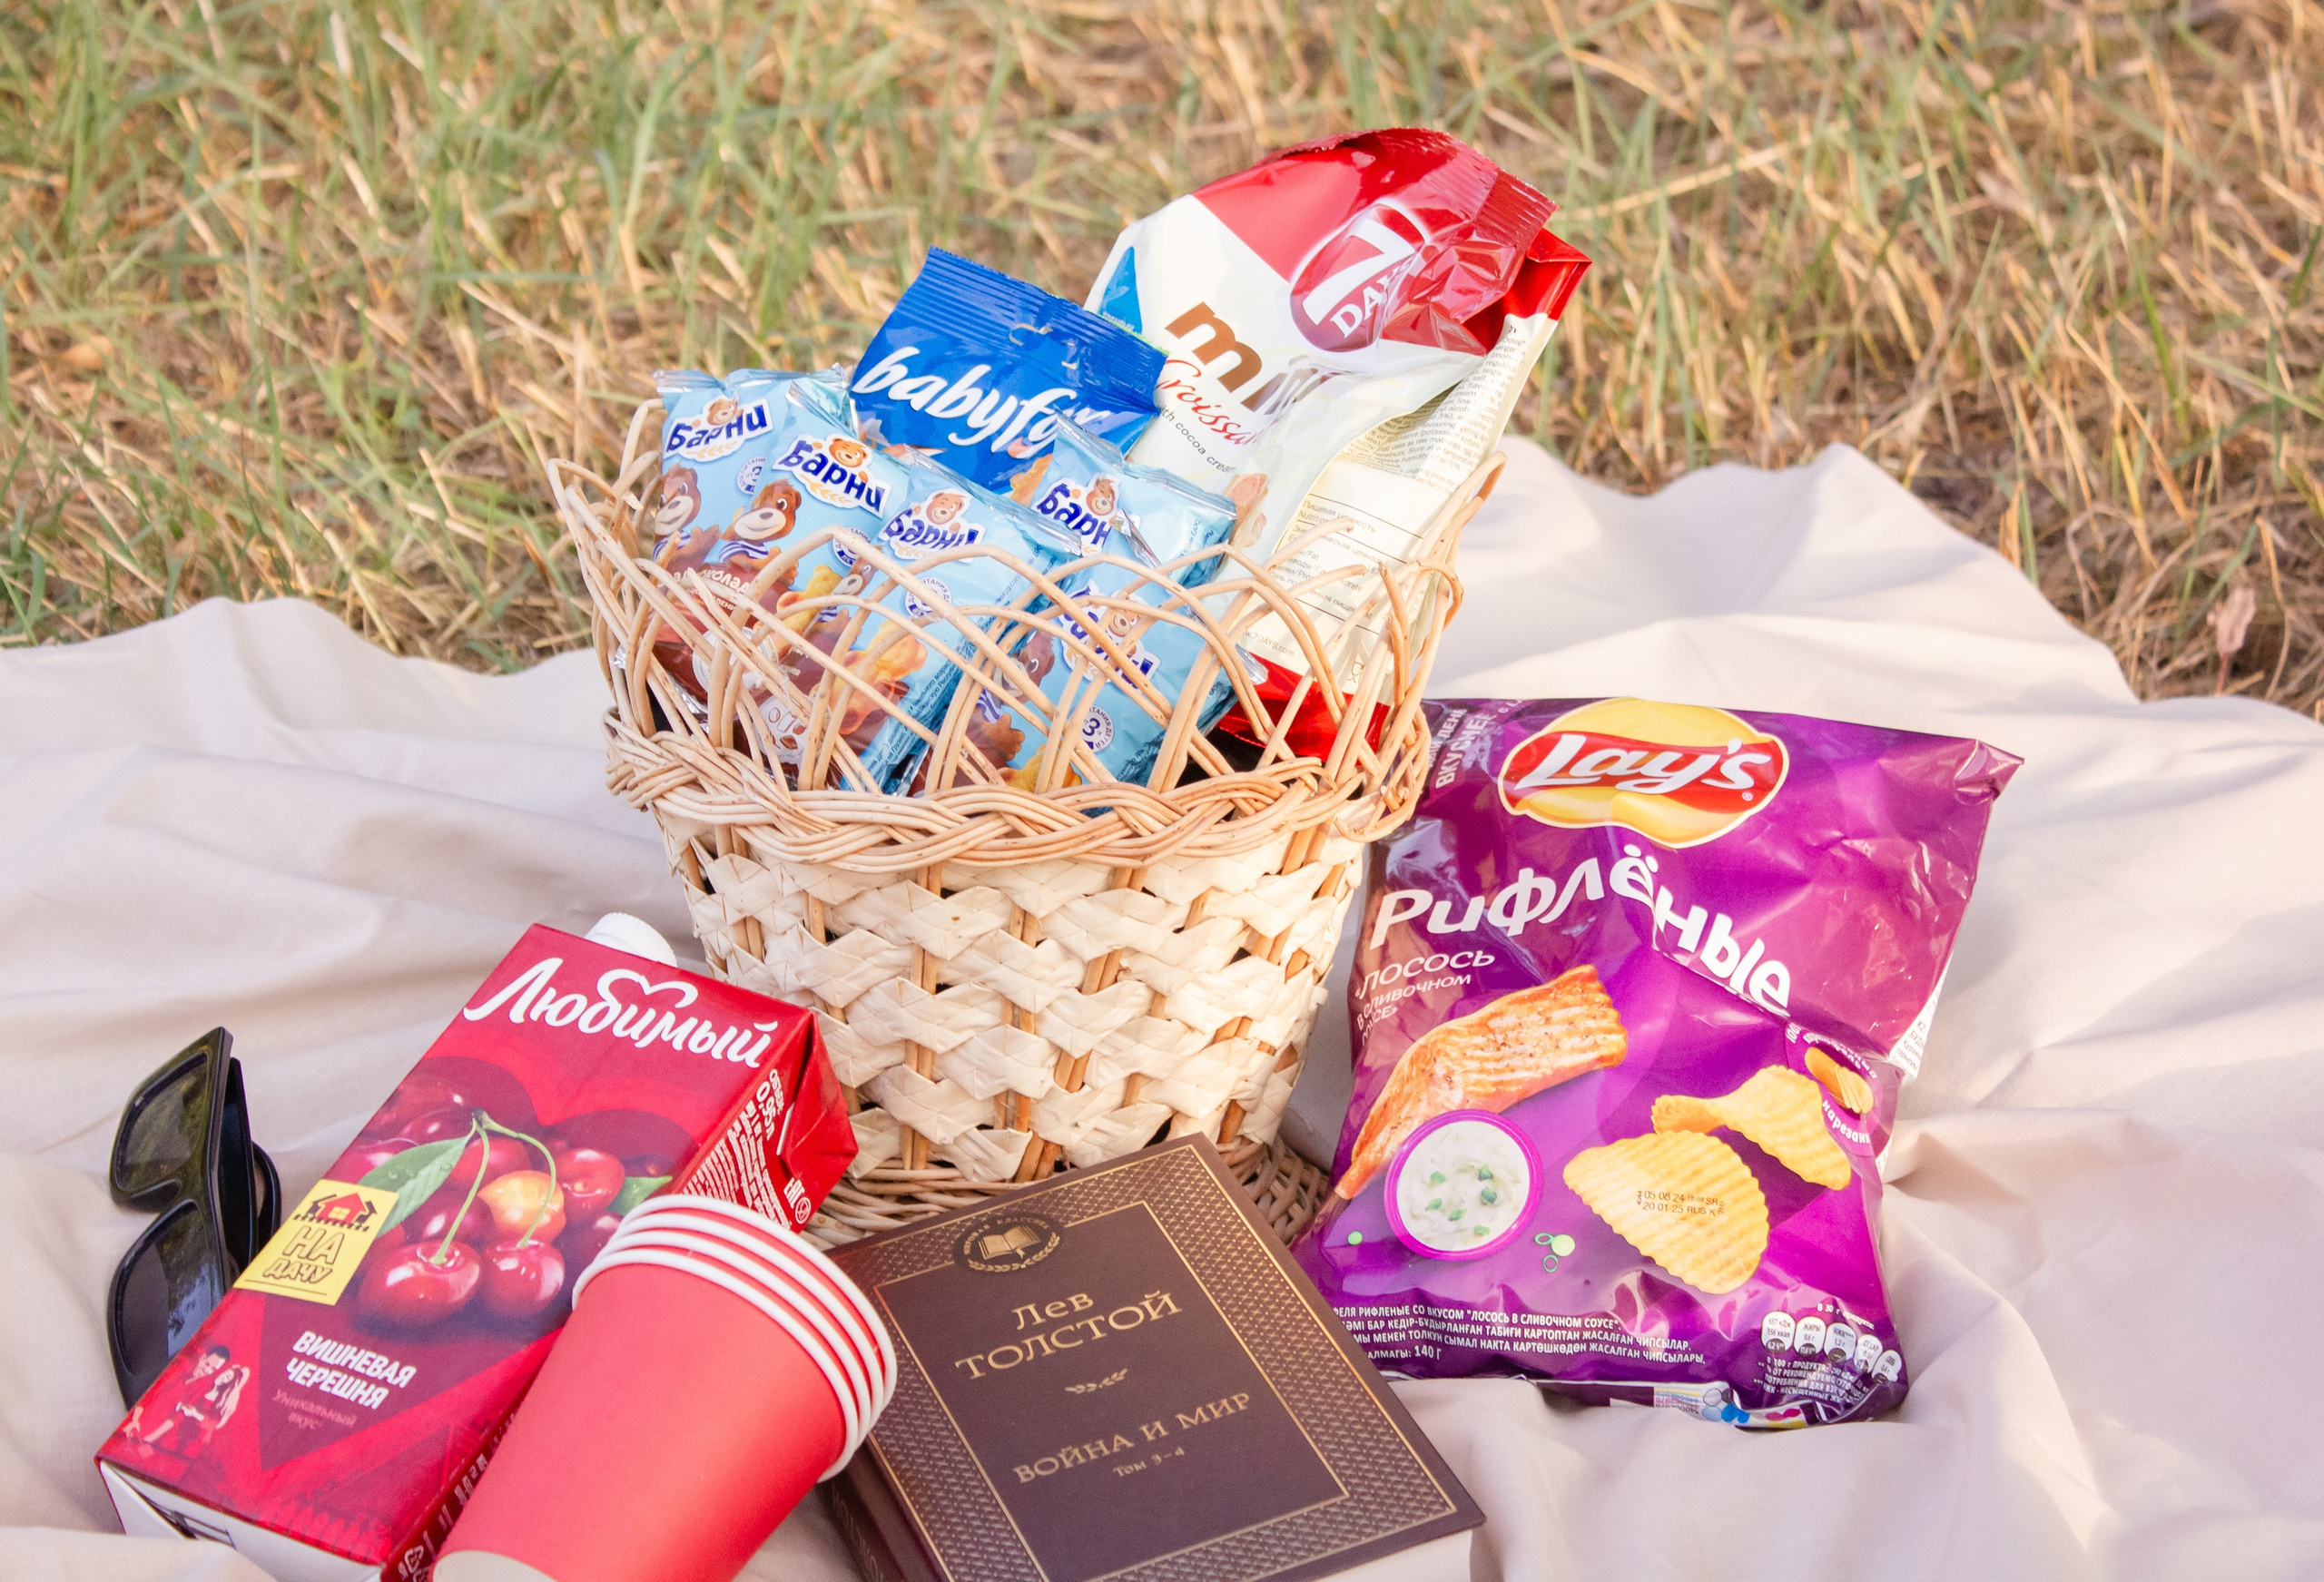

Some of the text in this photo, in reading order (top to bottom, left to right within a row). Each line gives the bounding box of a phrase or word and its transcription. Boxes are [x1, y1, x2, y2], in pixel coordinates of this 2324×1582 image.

[1303, 218, 1414, 326] 7
[665, 403, 768, 452] Барни
[1176, 422, 1206, 455] cocoa
[1401, 454, 1429, 463] humidity
[1408, 446, 1425, 454] Store
[778, 439, 885, 516] Барни
[1036, 482, 1113, 549] Барн
[1302, 500, 1336, 516] Пищевая
[884, 506, 980, 549] Барни
[1082, 717, 1101, 736] 3
[1514, 732, 1773, 795] Lay's
[463, 958, 778, 1068] Любимый
[1642, 1202, 1655, 1211] 20
[1657, 1203, 1669, 1212] 01
[1671, 1204, 1684, 1214] 25
[1687, 1206, 1707, 1215] RUS
[1659, 1192, 1670, 1201] 08
[1672, 1193, 1685, 1203] 24
[281, 1225, 346, 1265] НА
[261, 1257, 333, 1284] ДАЧУ
[1010, 1292, 1094, 1331] Лев
[1359, 1305, 1410, 1317] РИФЛЕНЫЕ
[1413, 1304, 1424, 1314] СО
[1427, 1306, 1463, 1321] ВКУСОМ
[1466, 1310, 1510, 1323] "ЛОСОСЬ
[1512, 1314, 1518, 1324] В
[1521, 1313, 1581, 1328] СЛИВОЧНОМ
[954, 1290, 1183, 1380] ТОЛСТОЙ
[1345, 1322, 1364, 1331] ӘМІ
[1367, 1321, 1385, 1331] БАР
[1524, 1329, 1580, 1341] КАРТОПТАН
[1582, 1331, 1633, 1346] ЖАСАЛҒАН
[1636, 1337, 1691, 1351] ЧИПСЫЛАР.
[1366, 1350, 1412, 1360] АЛМАГЫ:
[1414, 1345, 1434, 1359] 140
[1373, 1333, 1406, 1343] МЕНЕН
[1408, 1330, 1443, 1343] ТОЛКУН
[1444, 1335, 1478, 1349] СЫМАЛ
[1480, 1339, 1511, 1351] НАКТА
[1589, 1343, 1640, 1359] ЖАСАЛГАН
[291, 1331, 418, 1389] ВИШНЕВАЯ
[286, 1357, 389, 1410] ЧЕРЕШНЯ
[1012, 1392, 1251, 1484] ВОЙНА И МИР
[1113, 1460, 1147, 1477] Том
